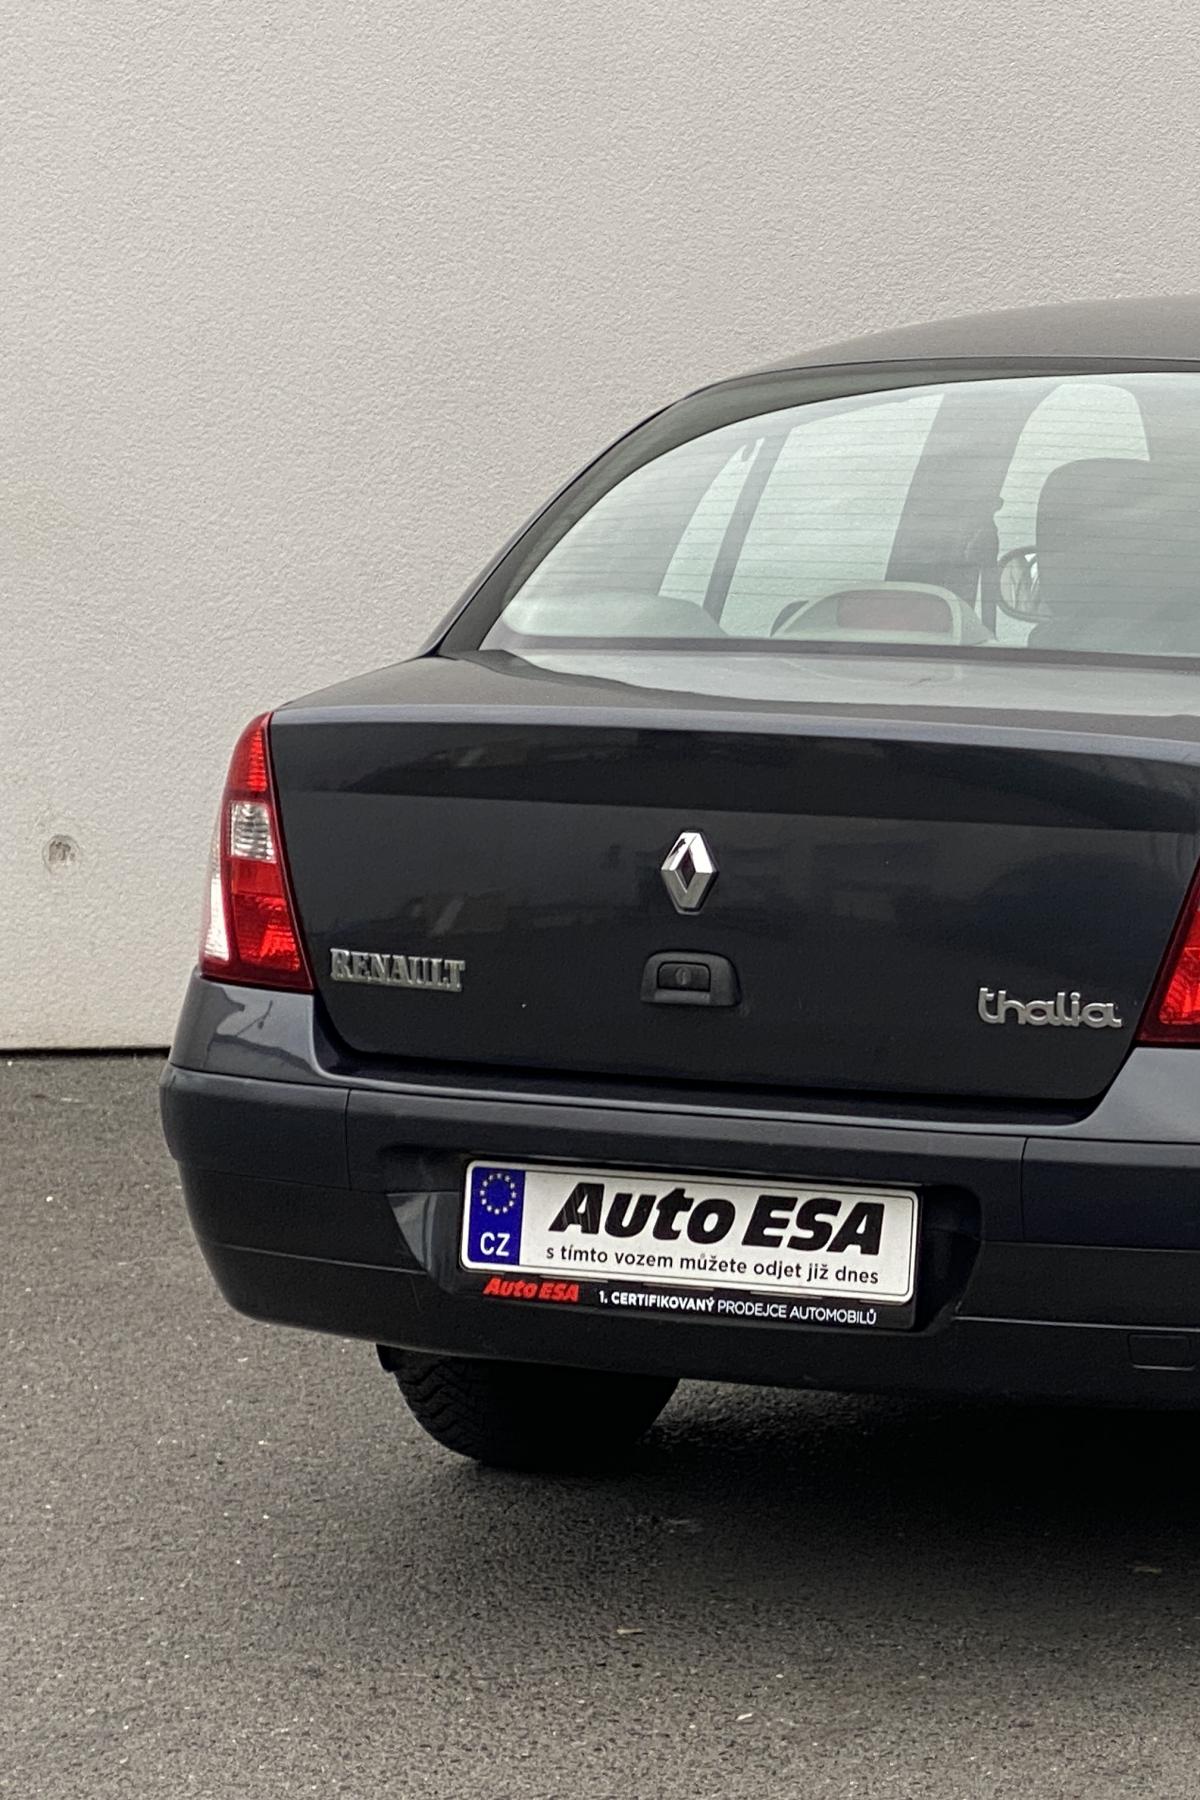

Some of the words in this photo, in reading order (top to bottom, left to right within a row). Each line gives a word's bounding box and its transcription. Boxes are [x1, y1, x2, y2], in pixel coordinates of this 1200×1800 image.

[330, 947, 465, 992] RENAULT
[549, 1182, 736, 1240] Auto
[741, 1195, 884, 1256] ESA
[479, 1232, 509, 1257] CZ
[546, 1246, 554, 1259] s
[561, 1244, 608, 1264] tímto
[614, 1252, 673, 1269] vozem
[680, 1252, 747, 1275] můžete
[754, 1259, 801, 1280] odjet
[805, 1262, 829, 1282] již
[835, 1264, 879, 1285] dnes
[483, 1276, 538, 1298] Auto
[538, 1282, 580, 1302] ESA
[598, 1291, 609, 1304] 1.
[611, 1292, 714, 1313] CERTIFIKOVANÝ
[717, 1300, 786, 1318] PRODEJCE
[789, 1306, 877, 1325] AUTOMOBILŮ
